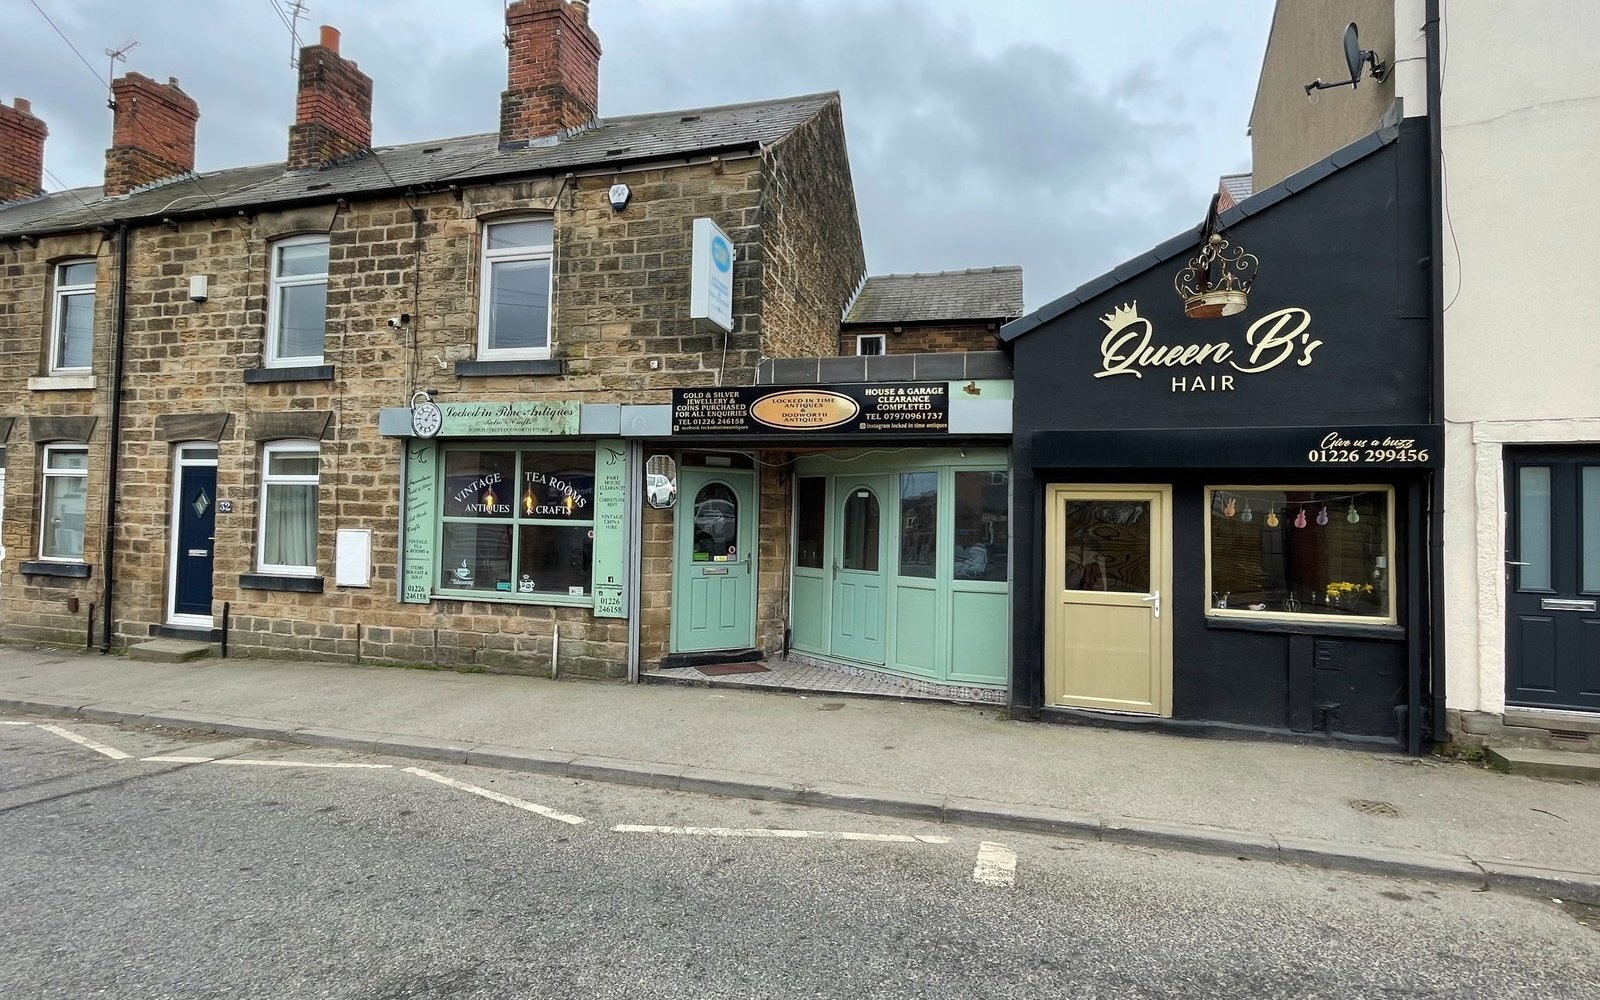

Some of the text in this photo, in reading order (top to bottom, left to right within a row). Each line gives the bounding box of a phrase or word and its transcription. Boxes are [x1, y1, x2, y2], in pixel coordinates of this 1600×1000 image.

[1093, 307, 1324, 379] Queen B's
[1171, 375, 1235, 392] HAIR
[865, 388, 896, 396] HOUSE
[906, 387, 944, 395] GARAGE
[878, 395, 930, 403] CLEARANCE
[523, 404, 574, 420] Antiques
[876, 403, 932, 411] COMPLETED
[707, 410, 748, 418] ENQUIRIES
[1320, 432, 1351, 450] Give
[1353, 440, 1368, 448] us
[1382, 436, 1416, 449] buzz
[1308, 449, 1430, 462] 01226 299456
[454, 471, 587, 508] VINTAGE TEA ROOMS
[465, 504, 510, 515] ANTIQUES
[535, 505, 572, 515] CRAFTS
